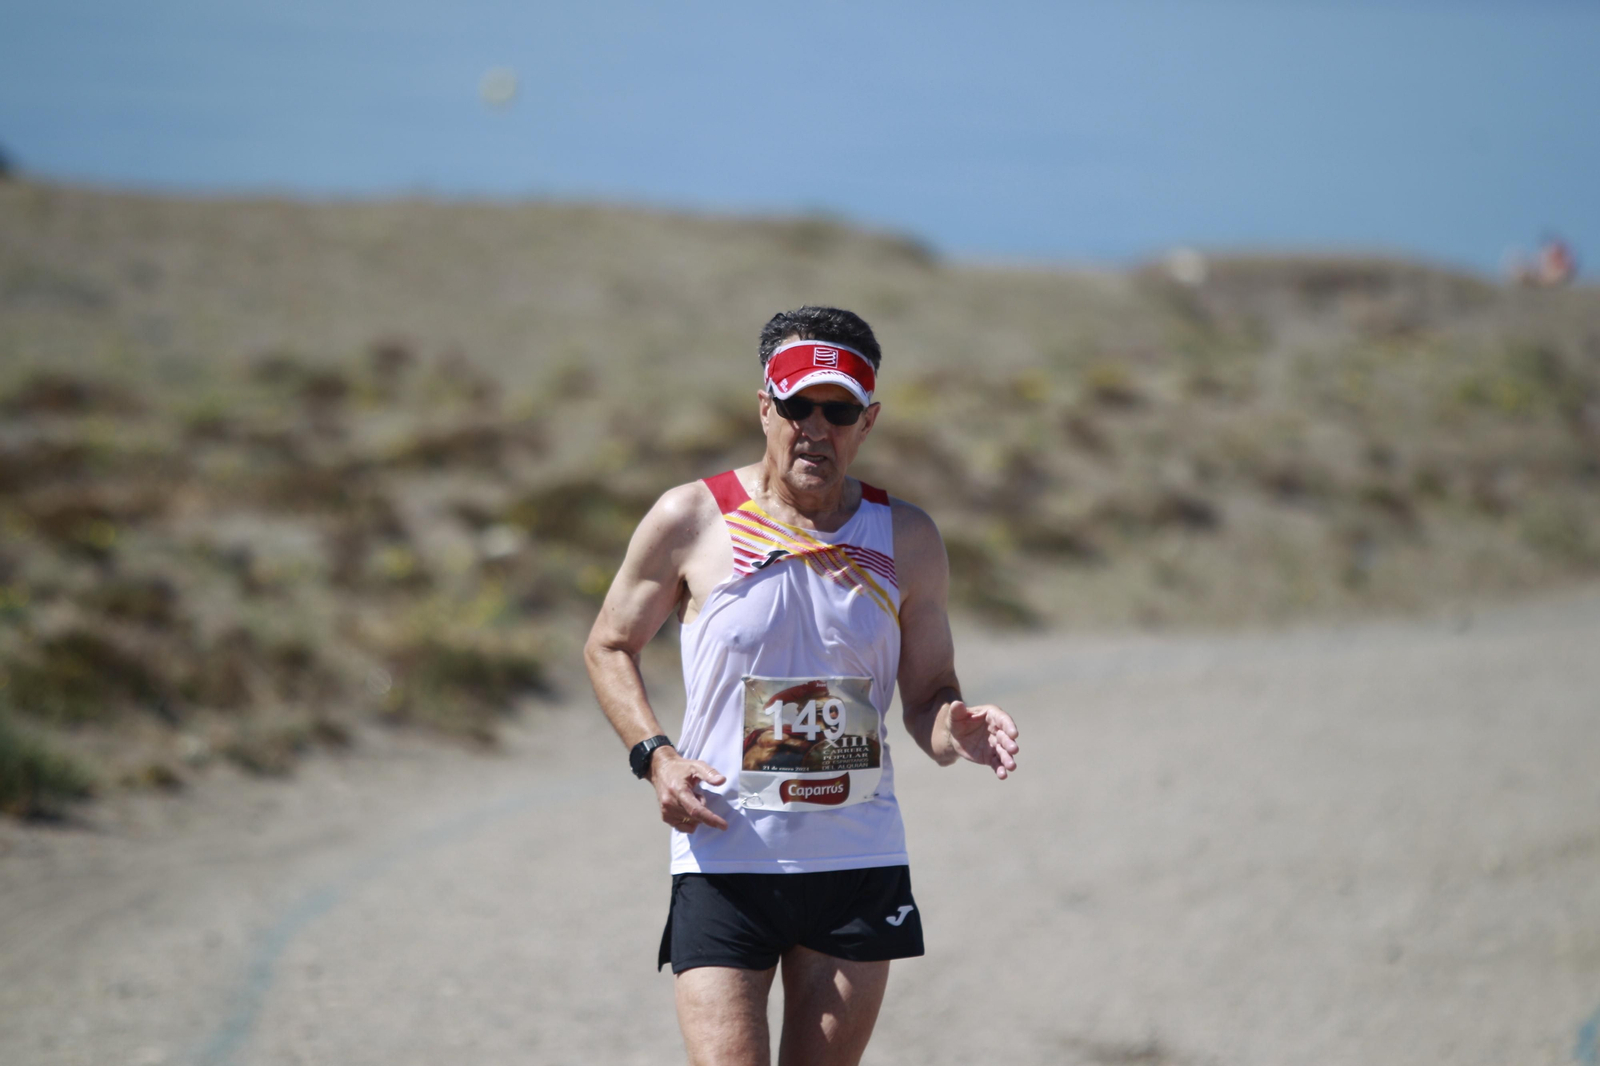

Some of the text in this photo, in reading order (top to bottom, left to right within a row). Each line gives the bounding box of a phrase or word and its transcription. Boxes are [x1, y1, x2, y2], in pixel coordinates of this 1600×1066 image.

[764, 699, 846, 741] 149
[823, 735, 870, 750] XIII
[823, 747, 870, 755] CARRERA
[823, 752, 868, 761] POPULAR
